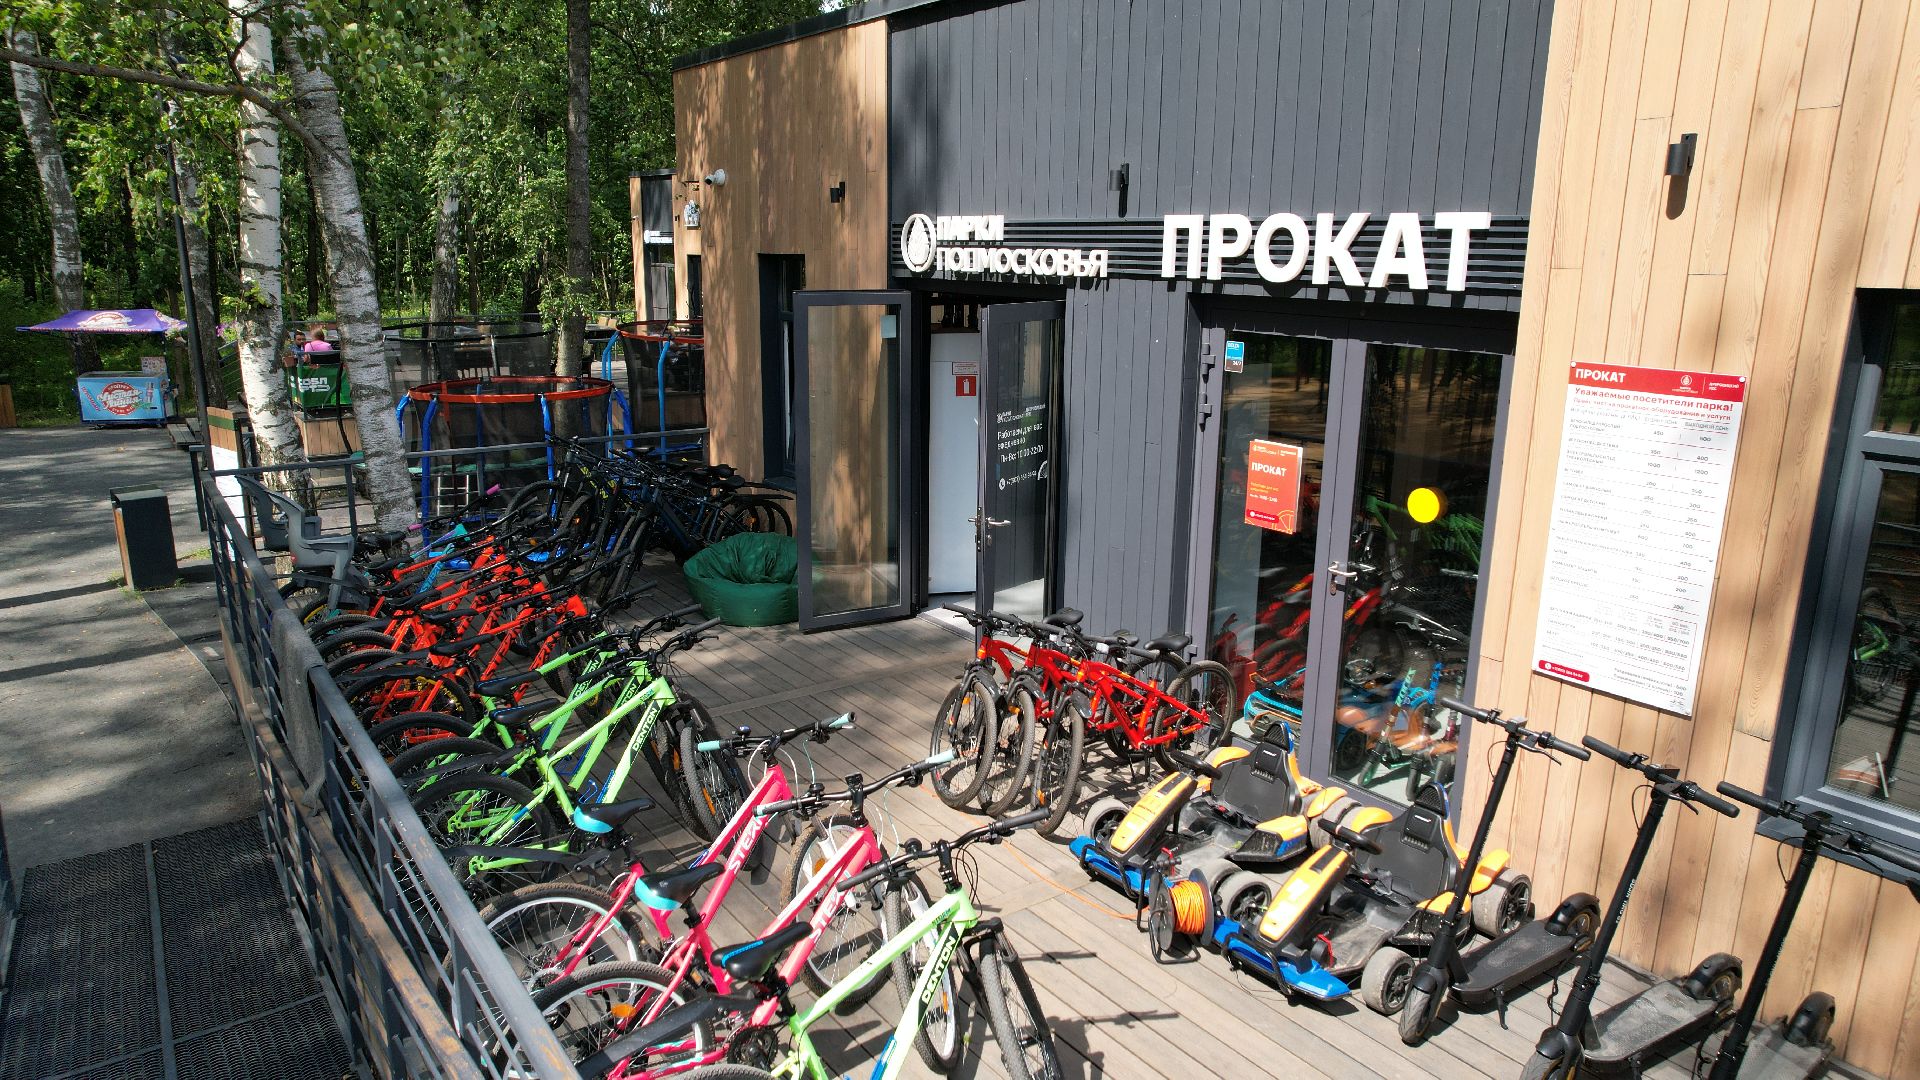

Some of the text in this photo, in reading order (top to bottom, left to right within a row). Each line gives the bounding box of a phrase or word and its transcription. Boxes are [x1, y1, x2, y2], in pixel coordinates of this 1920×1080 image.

[937, 215, 1004, 240] ПАРКИ
[937, 247, 1108, 278] ПОДМОСКОВЬЯ
[1161, 211, 1491, 292] ПРОКАТ
[1574, 368, 1626, 383] ПРОКАТ
[1574, 387, 1734, 412] Уважаемые посетители парка!
[1650, 406, 1700, 418] оборудование
[1705, 412, 1731, 421] услуги
[1251, 461, 1287, 477] ПРОКАТ
[1696, 454, 1709, 462] 400
[632, 707, 658, 752] DENTON
[921, 935, 957, 1005] DENTON
